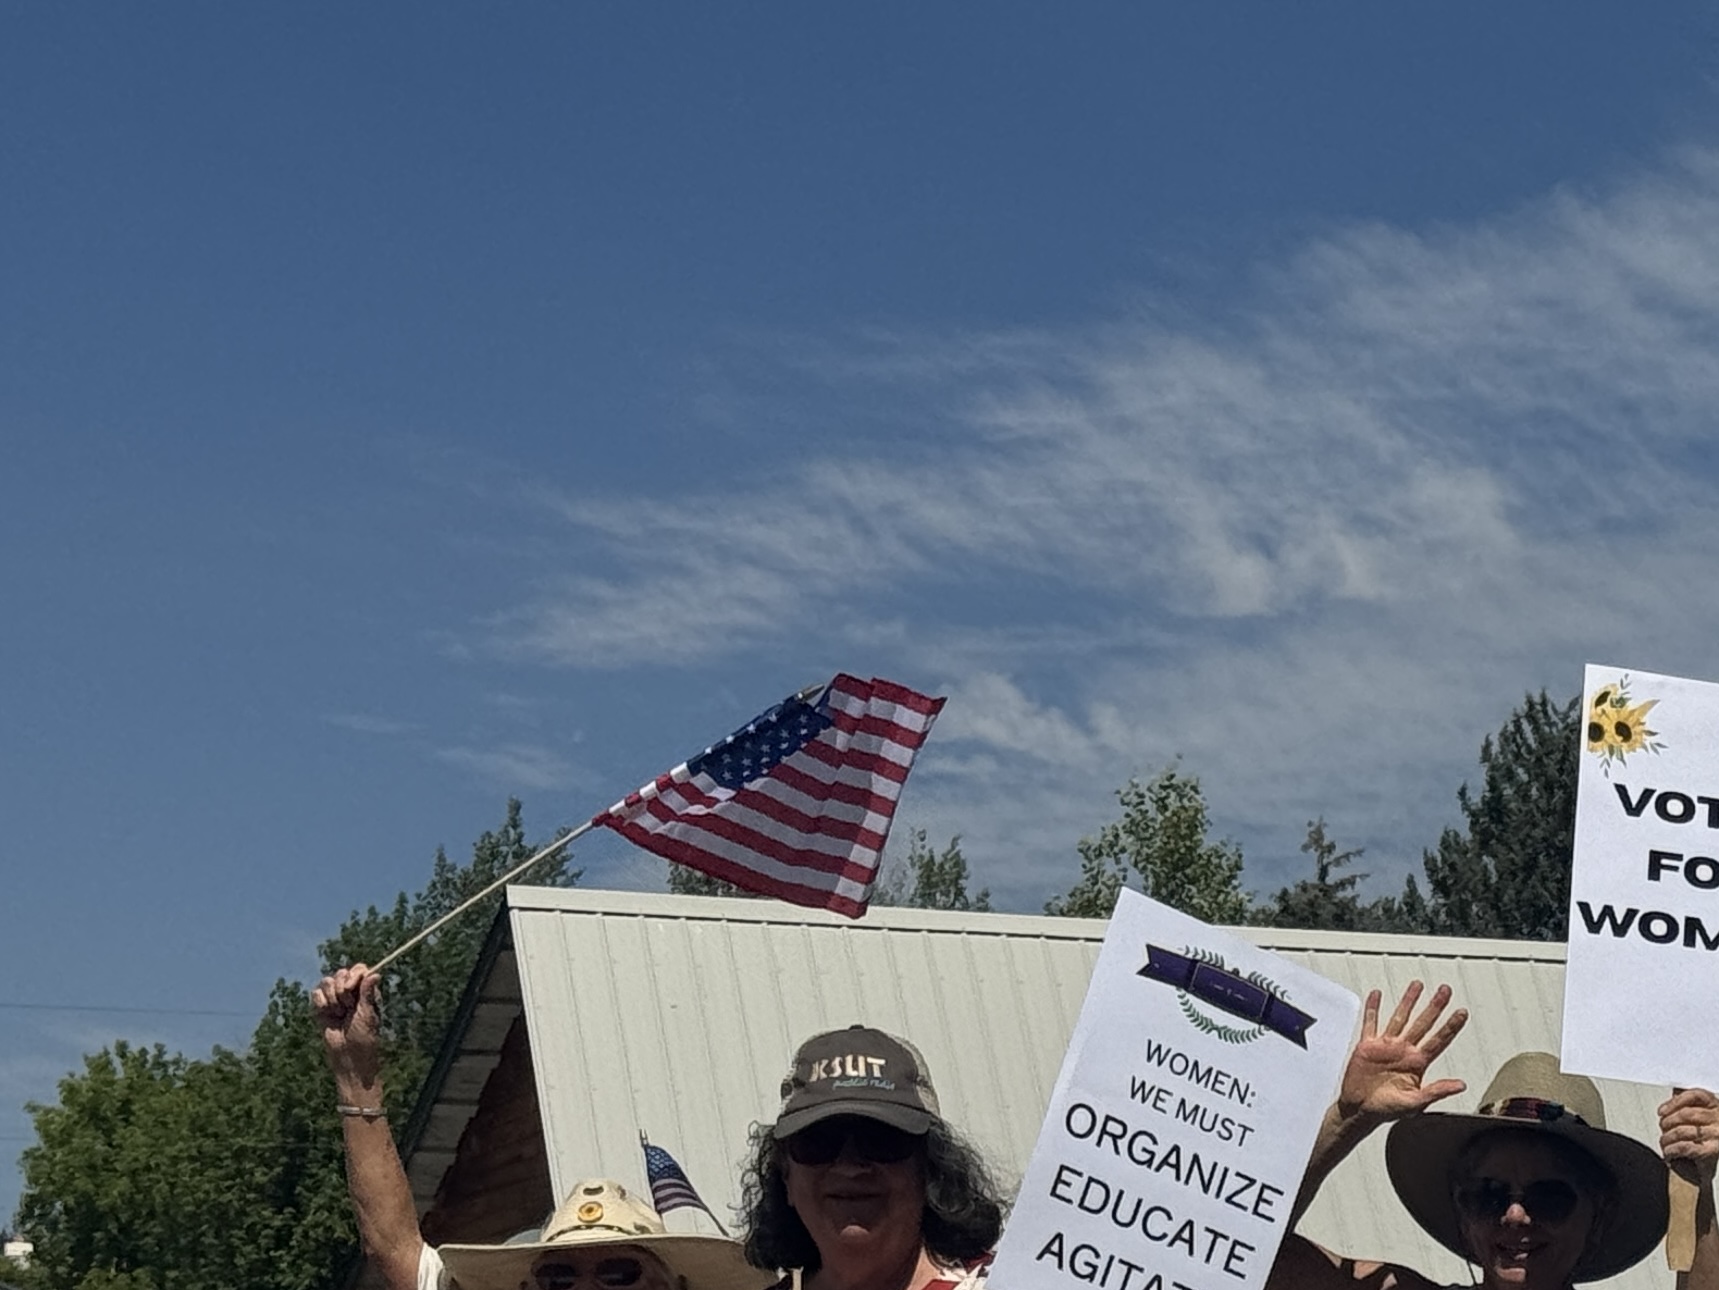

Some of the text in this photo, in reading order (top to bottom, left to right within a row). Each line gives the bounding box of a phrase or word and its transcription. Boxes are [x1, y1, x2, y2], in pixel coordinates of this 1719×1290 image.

[1129, 1075, 1255, 1148] WE MUST
[1146, 1038, 1257, 1108] WOMEN:
[1065, 1102, 1285, 1224] ORGANIZE
[1049, 1164, 1256, 1281] EDUCATE
